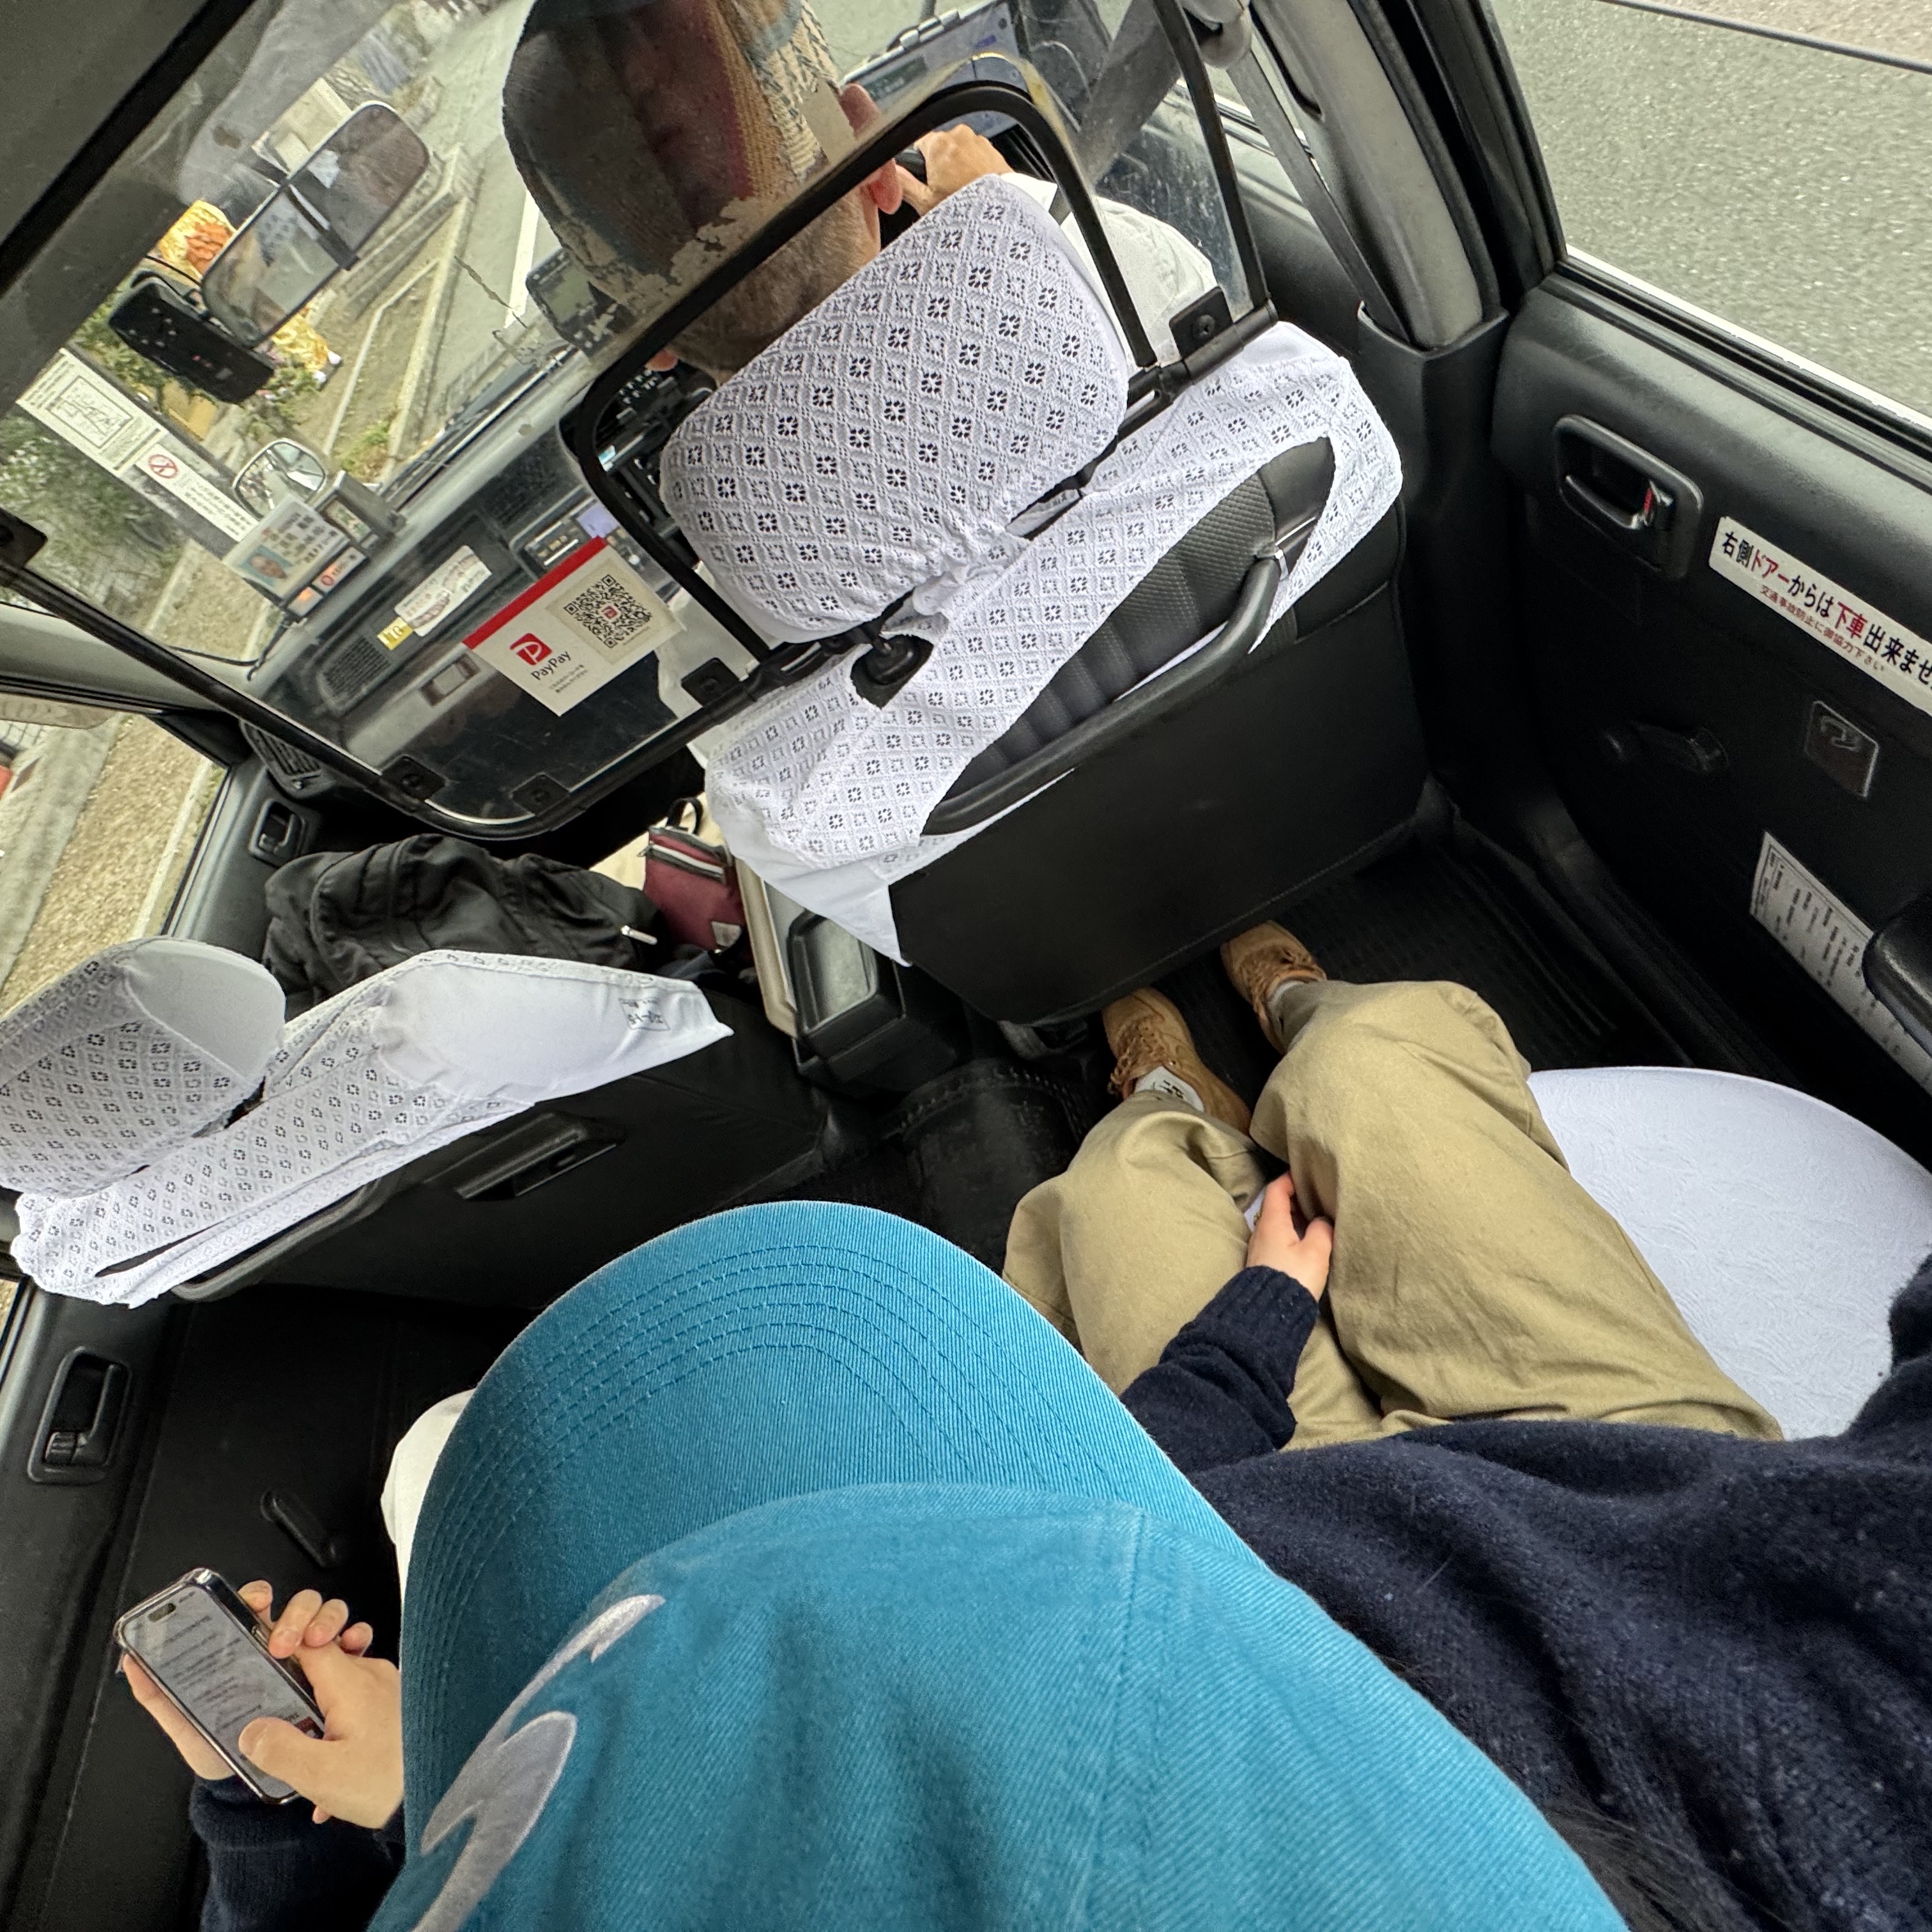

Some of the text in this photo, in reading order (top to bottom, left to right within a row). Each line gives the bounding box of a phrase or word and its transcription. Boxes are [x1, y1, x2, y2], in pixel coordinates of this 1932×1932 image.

[1721, 531, 1932, 691] 右側ドアーからは下車出来ませ
[530, 650, 572, 681] PayPay
